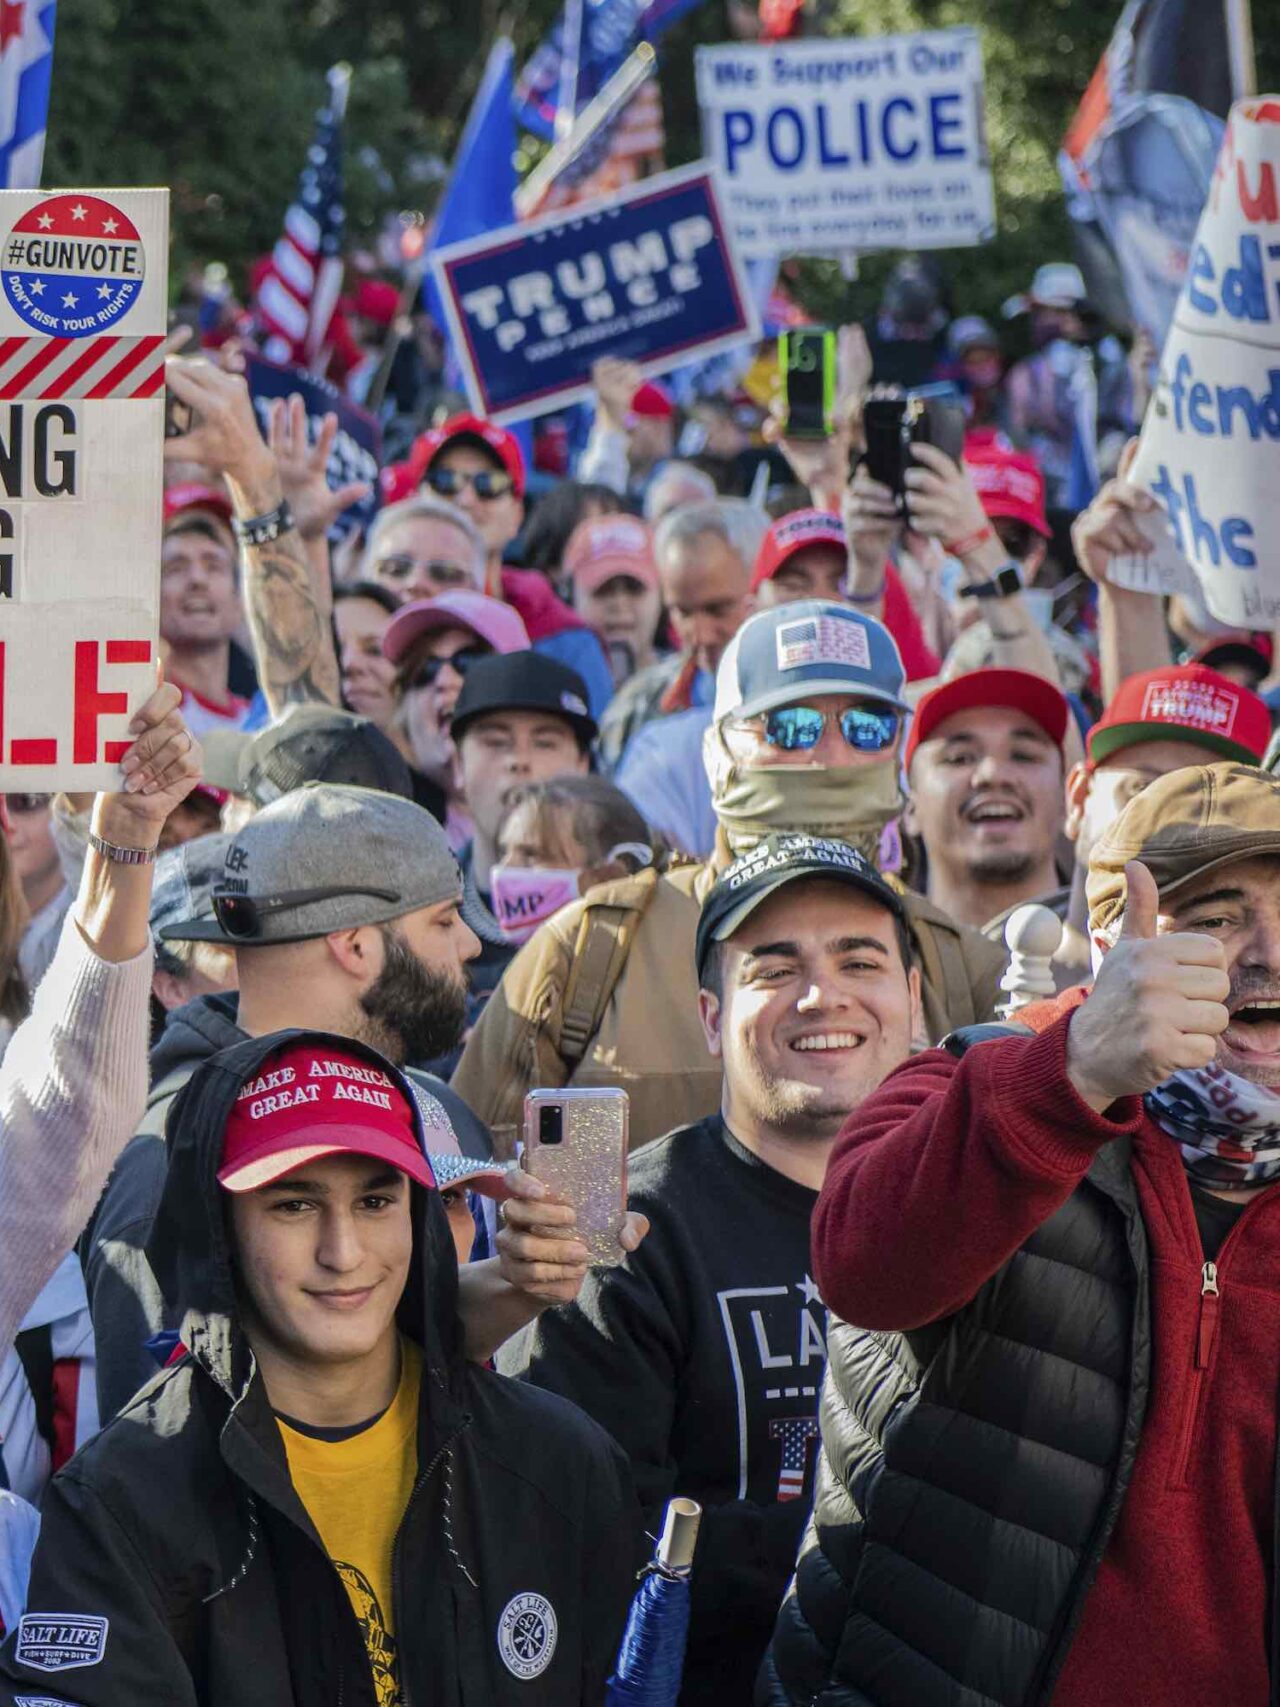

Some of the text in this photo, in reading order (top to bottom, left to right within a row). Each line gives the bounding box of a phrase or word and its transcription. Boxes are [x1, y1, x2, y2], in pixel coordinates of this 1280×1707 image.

[715, 45, 964, 86] We Support Our
[723, 92, 968, 176] POLICE
[461, 213, 715, 331] TRUMP
[8, 275, 34, 310] DON'T
[30, 306, 60, 330] RISK
[61, 316, 97, 331] YOUR
[495, 260, 703, 353] PENCE
[729, 848, 863, 891] GREAT AGAIN
[237, 1060, 395, 1101] MAKE AMERICA
[249, 1081, 393, 1120] GREAT AGAIN
[504, 1597, 548, 1630] SALT LIFE
[22, 1626, 100, 1646] SALT LIFE
